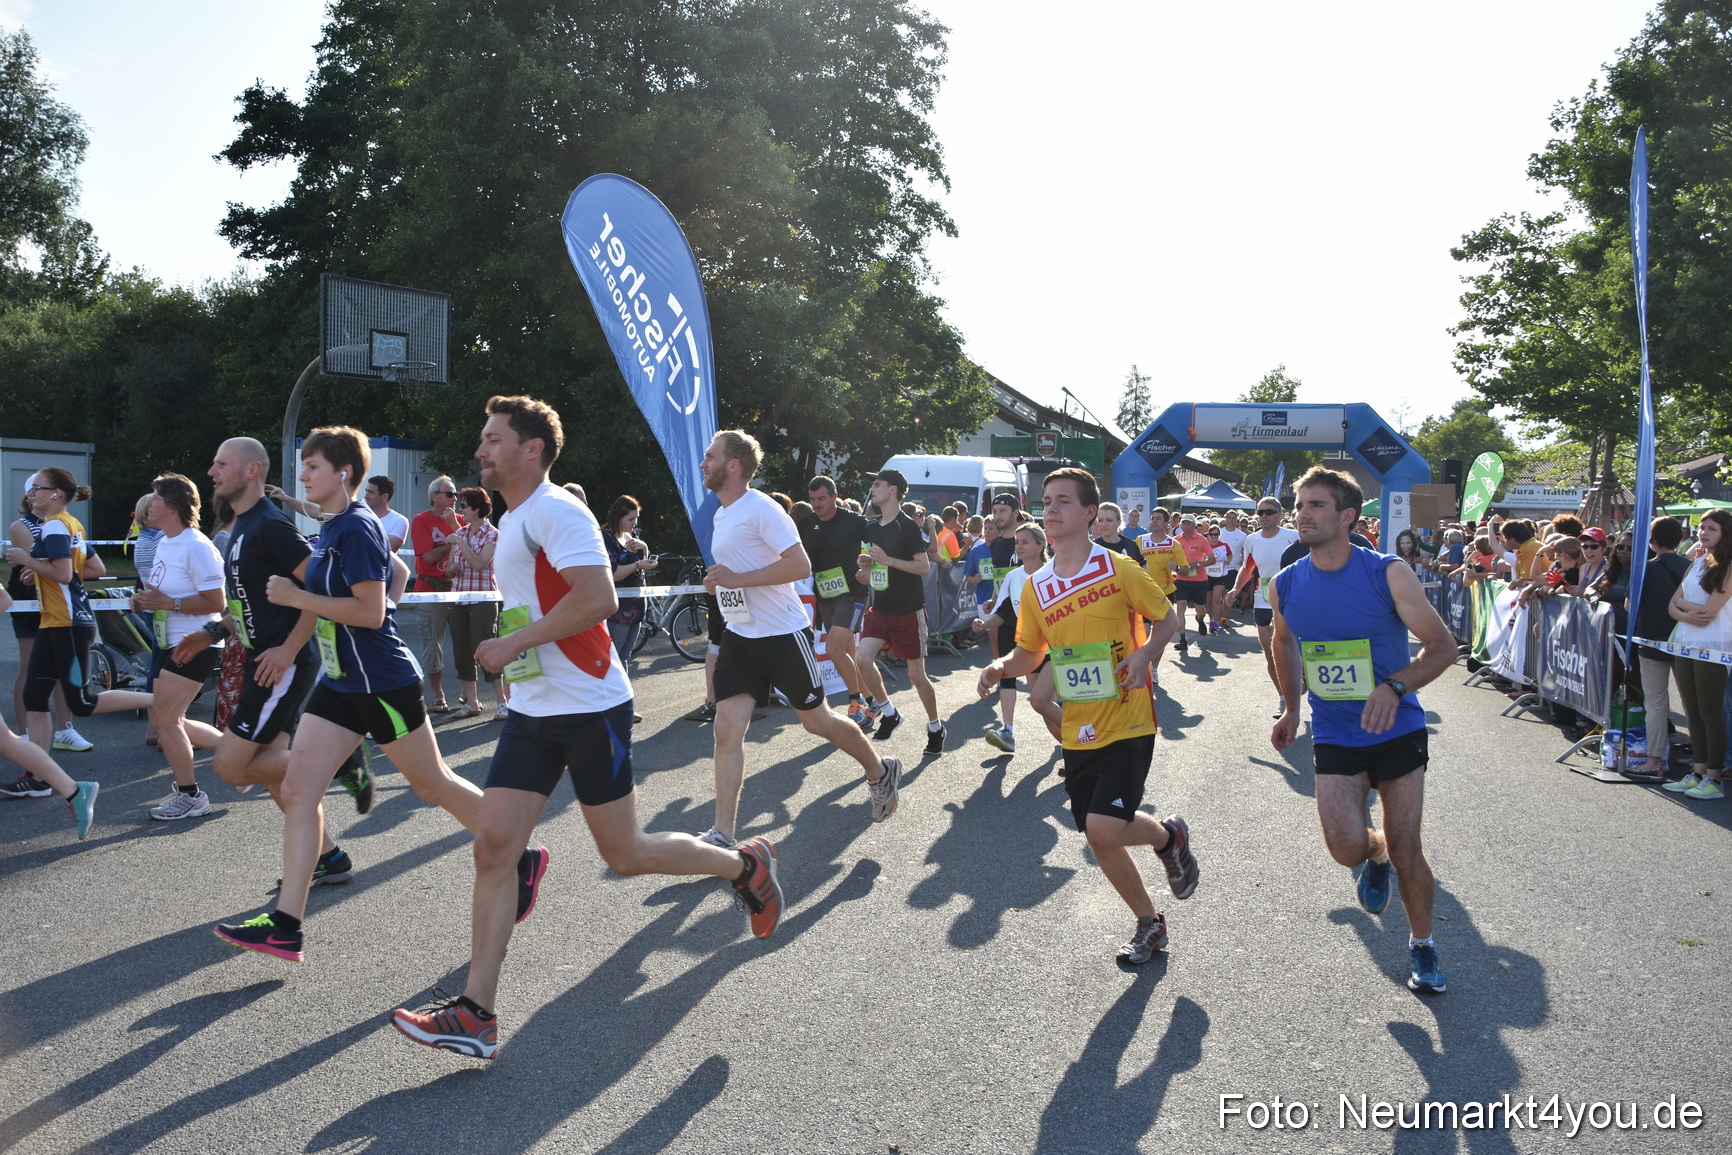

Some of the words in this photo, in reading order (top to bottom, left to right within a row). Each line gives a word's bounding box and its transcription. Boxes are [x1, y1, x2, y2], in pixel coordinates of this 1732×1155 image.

[1252, 426, 1309, 437] firmenlauf
[1464, 490, 1482, 512] AOK
[1543, 488, 1578, 496] Hallen
[819, 578, 845, 592] 1206
[871, 571, 886, 583] 1231
[231, 565, 256, 639] RAIL.ONE
[720, 590, 745, 608] 8934
[1044, 604, 1076, 627] MAX
[1077, 583, 1122, 609] BÖGL
[1552, 639, 1588, 678] Fischer
[1066, 666, 1102, 687] 941
[1317, 664, 1357, 685] 821
